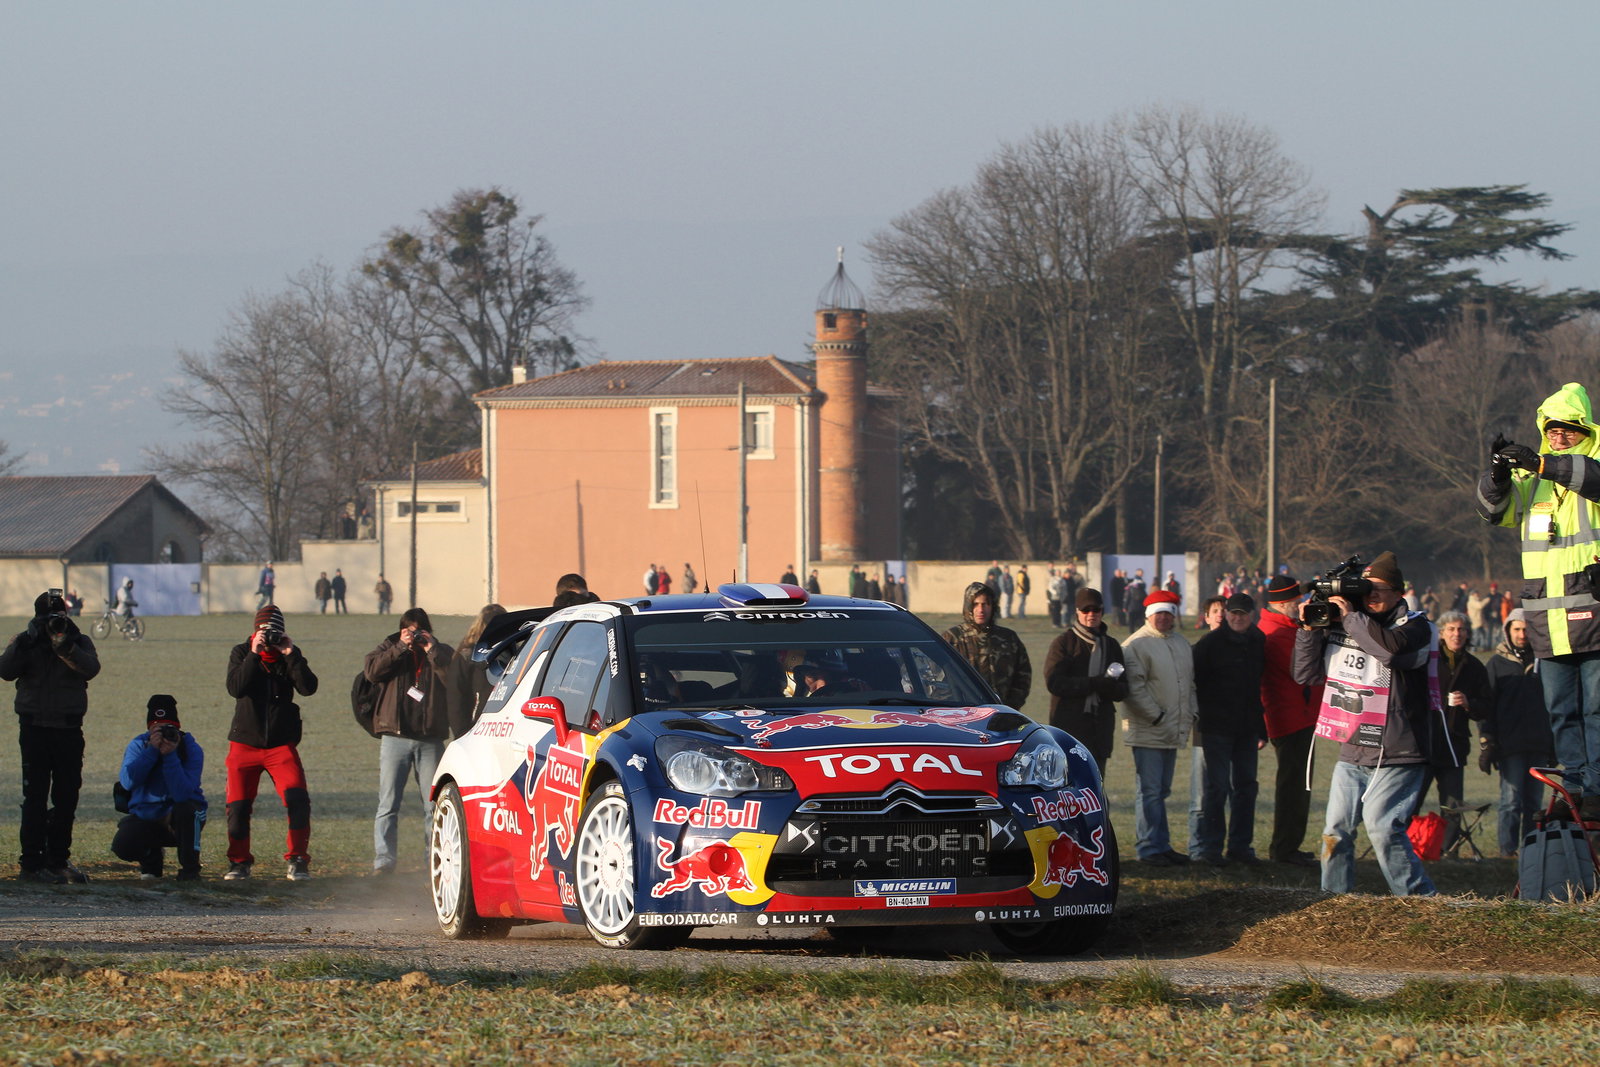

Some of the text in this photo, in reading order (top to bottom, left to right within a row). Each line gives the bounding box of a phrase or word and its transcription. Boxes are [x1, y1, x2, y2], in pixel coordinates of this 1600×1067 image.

[735, 611, 850, 619] CITROËN
[1344, 653, 1365, 669] 428
[473, 716, 514, 738] CITROËN
[803, 753, 983, 778] TOTAL
[549, 756, 580, 789] TOTAL
[479, 802, 523, 836] TOTAL
[822, 828, 985, 853] CITROËN
[823, 857, 987, 869] RACING
[881, 881, 952, 893] MICHELIN
[888, 896, 928, 907] BN-404-MV
[638, 913, 738, 926] EURODATACAR
[772, 914, 836, 924] LUHTA
[989, 910, 1041, 920] LUHTA
